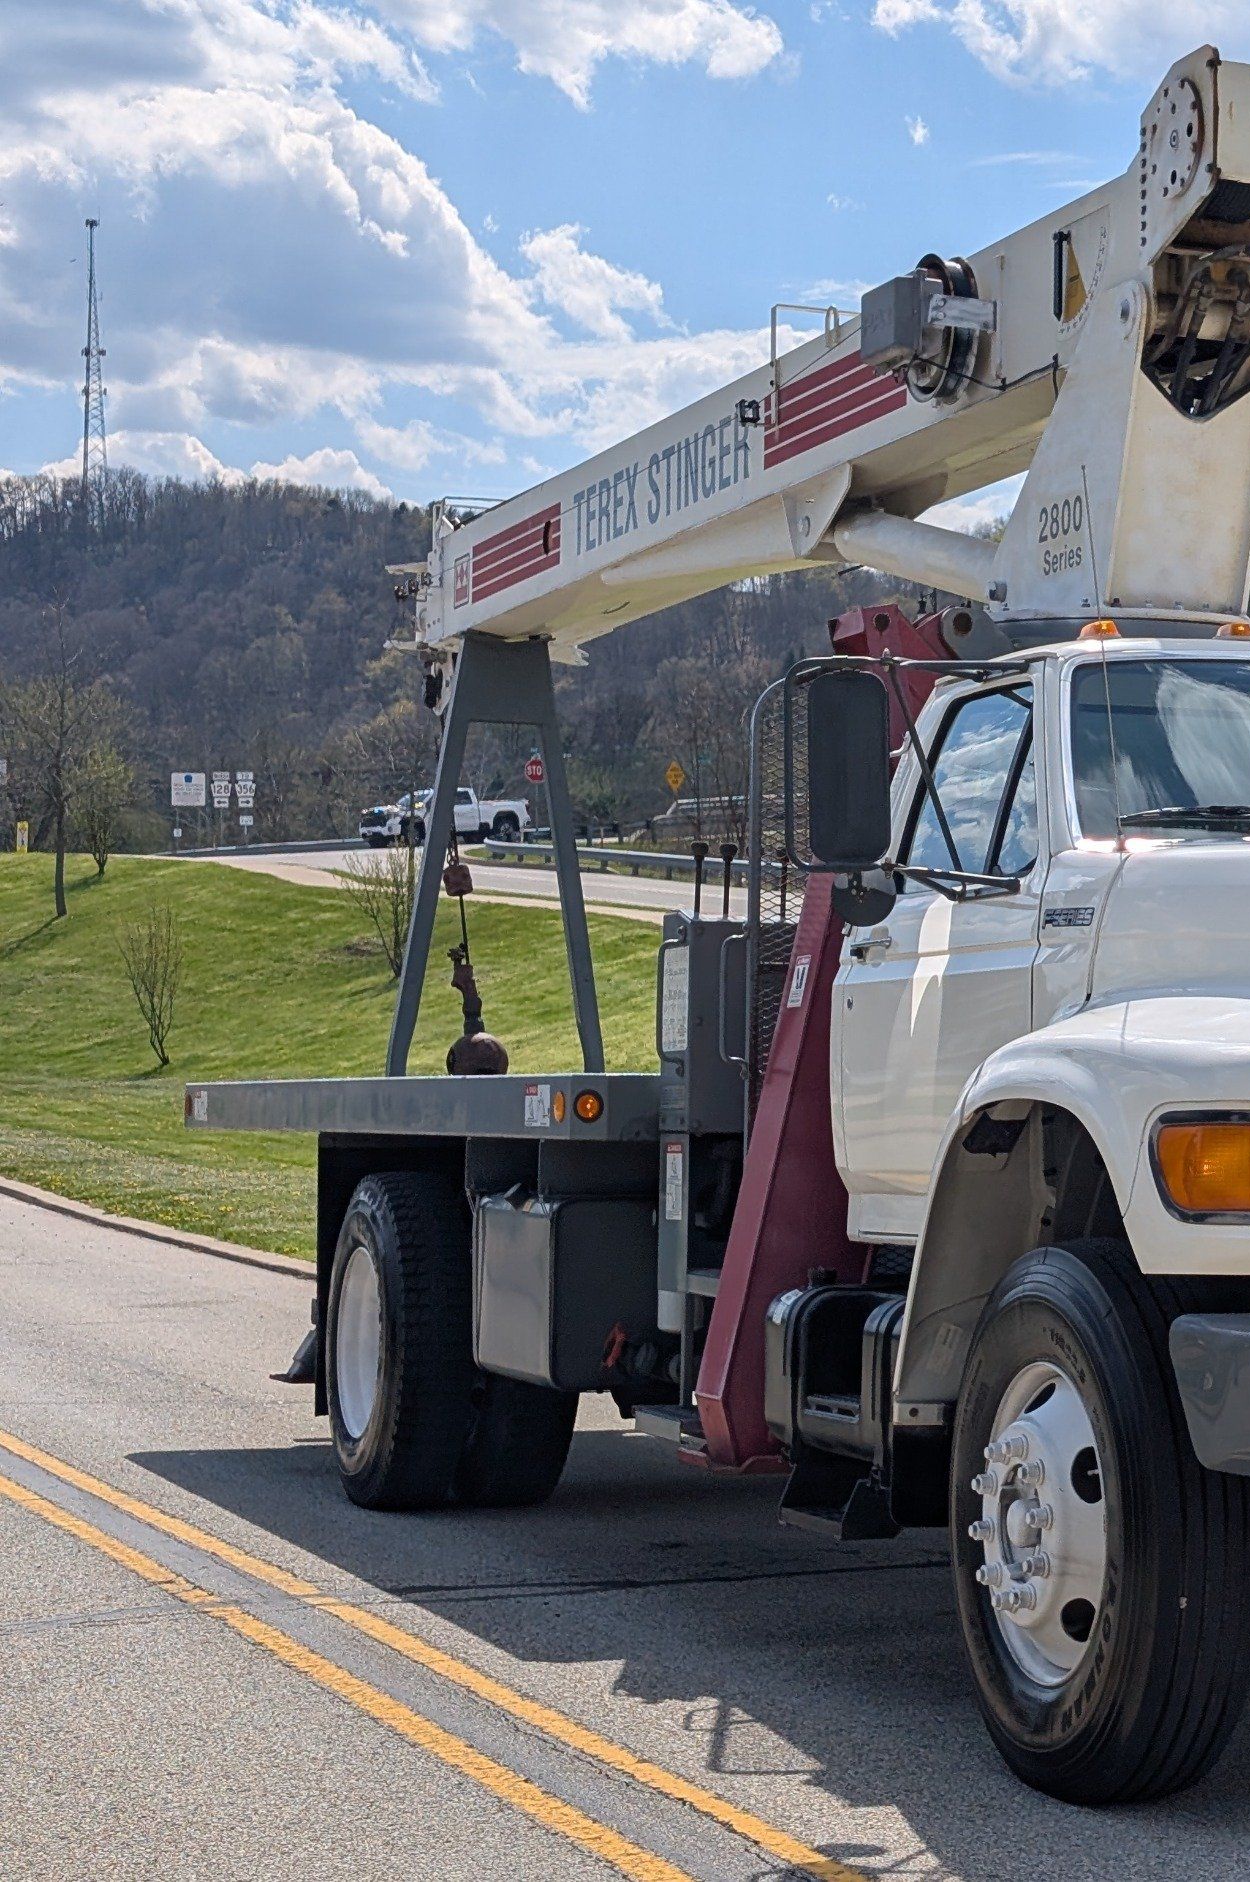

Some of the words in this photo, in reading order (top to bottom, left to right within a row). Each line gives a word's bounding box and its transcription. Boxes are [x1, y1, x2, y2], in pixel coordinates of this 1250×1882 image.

[573, 461, 639, 556] TEREX
[647, 412, 750, 525] STINGER
[1038, 494, 1083, 544] 2800
[1043, 544, 1082, 576] Series
[526, 765, 542, 776] STO
[213, 784, 230, 795] 128
[237, 784, 255, 795] 356
